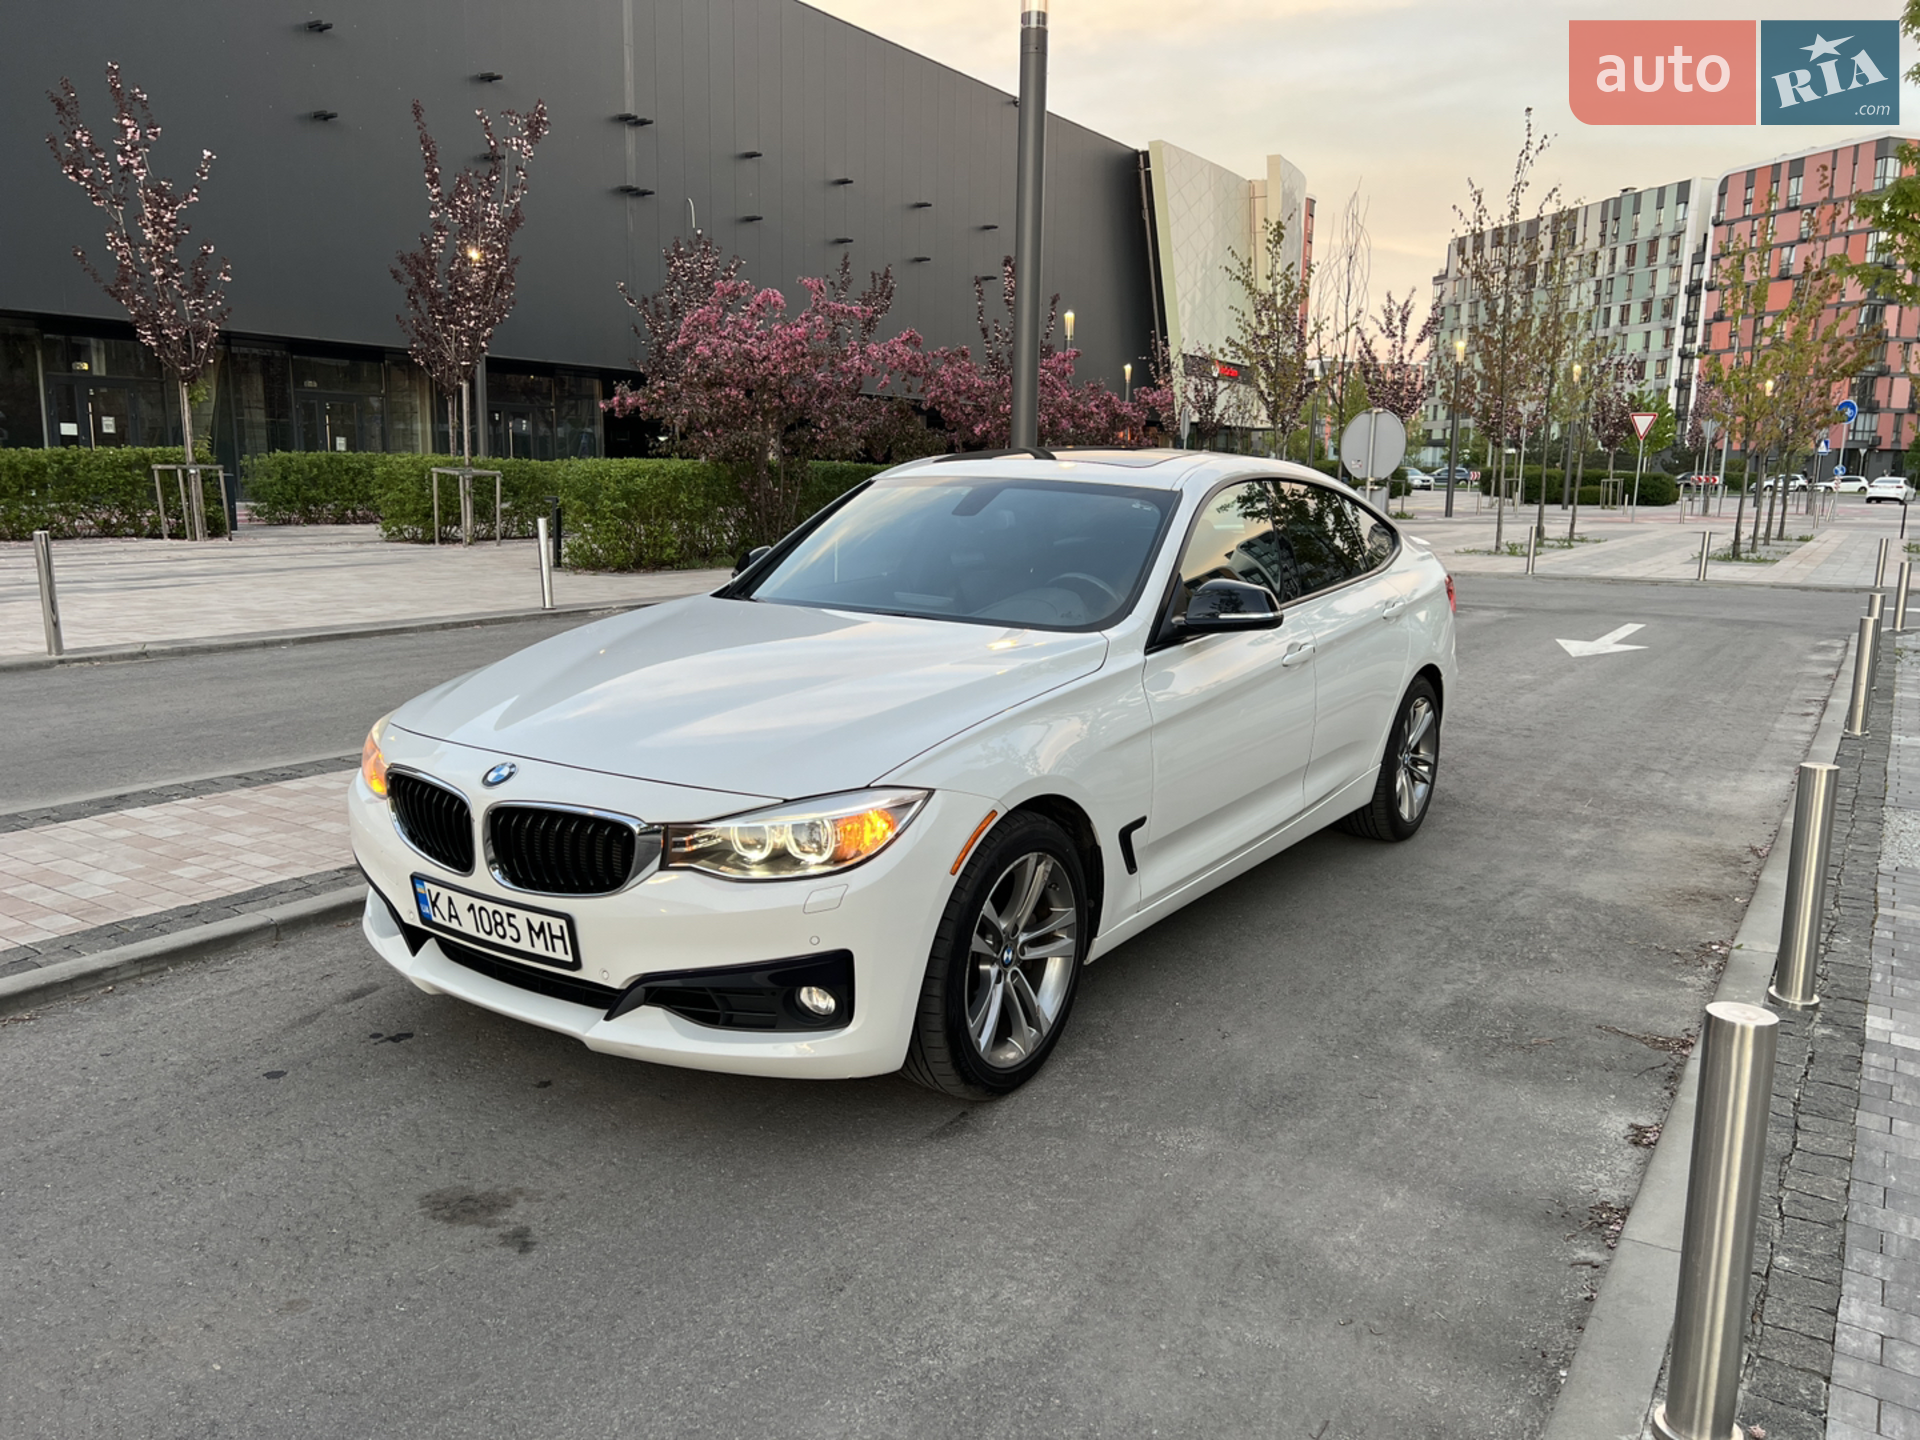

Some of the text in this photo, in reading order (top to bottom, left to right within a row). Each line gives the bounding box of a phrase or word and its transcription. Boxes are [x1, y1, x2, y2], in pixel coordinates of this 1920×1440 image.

[428, 889, 569, 956] KA 1085 MH
